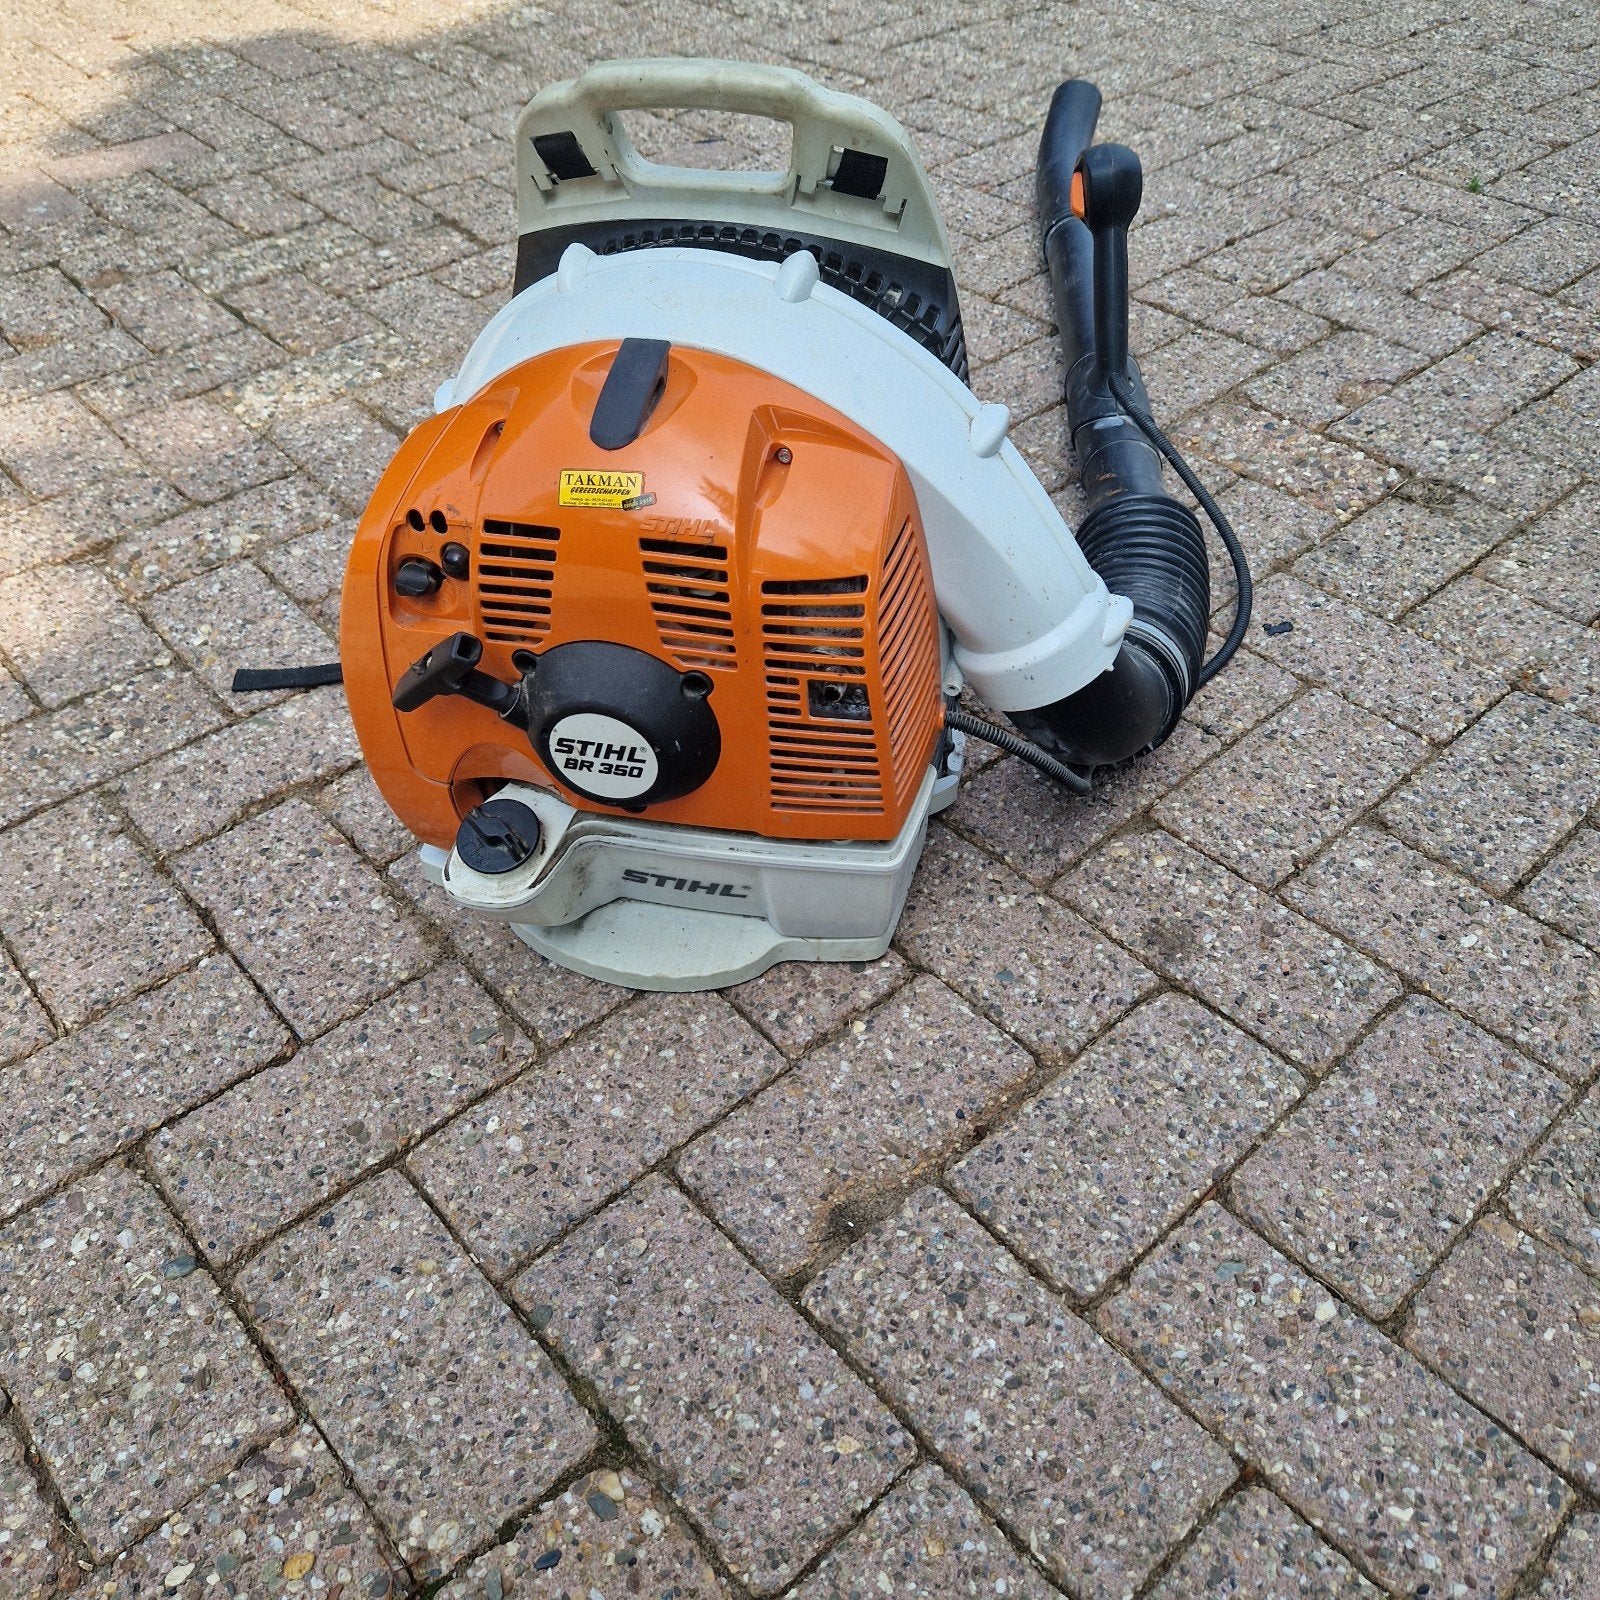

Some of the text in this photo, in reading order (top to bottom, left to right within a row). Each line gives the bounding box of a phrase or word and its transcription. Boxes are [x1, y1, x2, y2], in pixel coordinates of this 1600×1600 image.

[564, 473, 638, 488] TAKMAN
[570, 486, 632, 496] GEREEDSCHAPPEN
[638, 515, 716, 539] STIHL
[554, 737, 647, 764] STIHL
[563, 757, 644, 779] BR 350
[621, 868, 748, 899] STIHL
